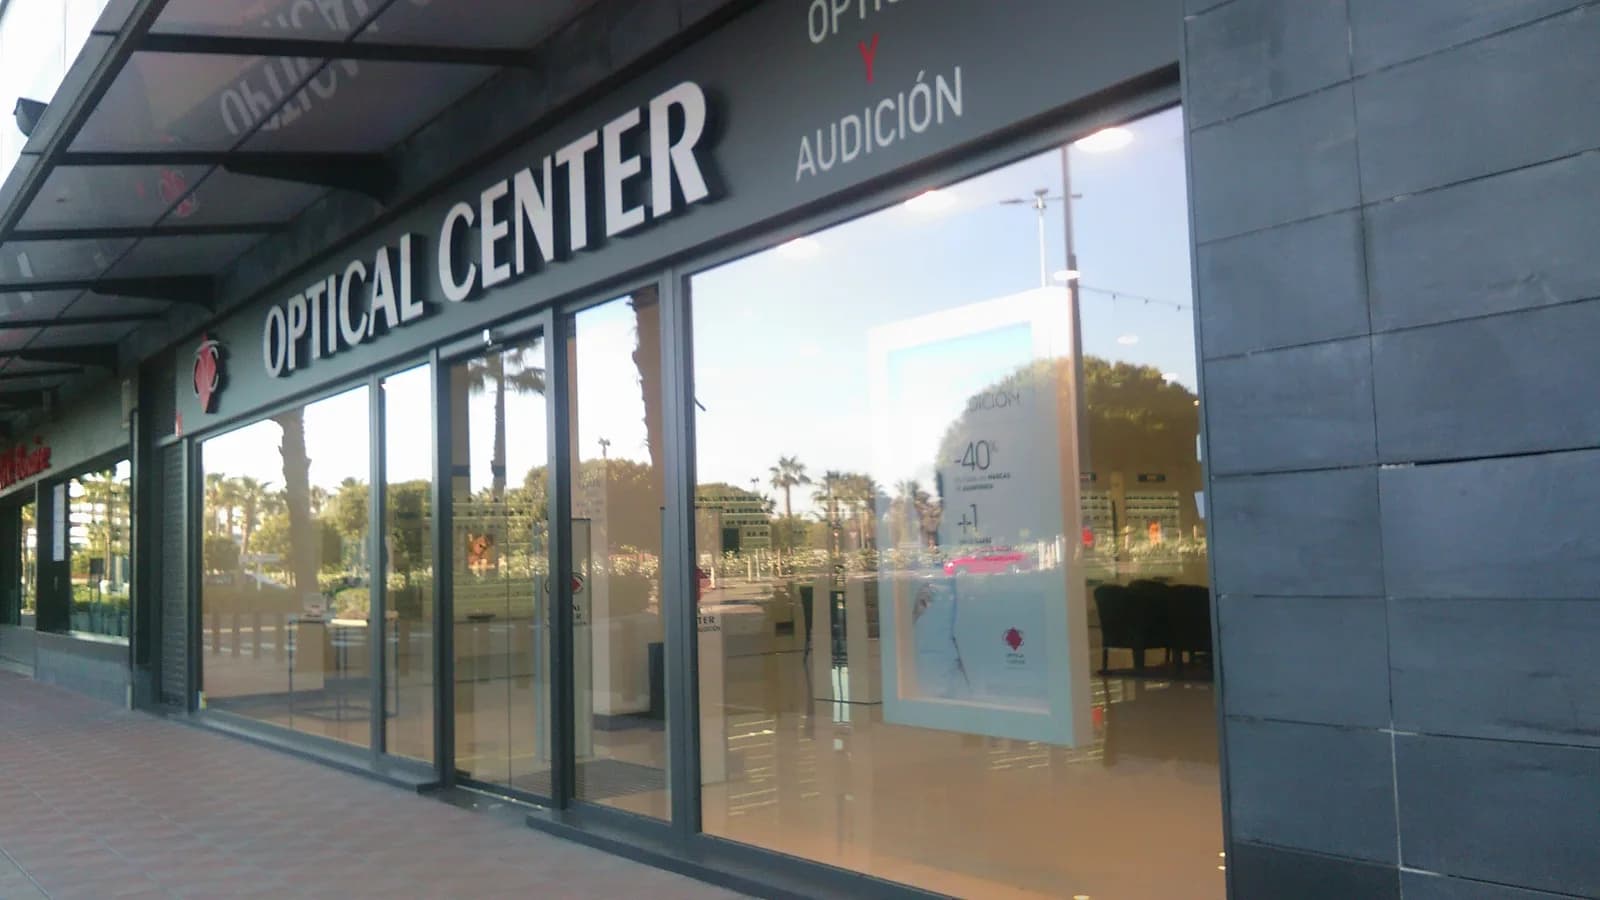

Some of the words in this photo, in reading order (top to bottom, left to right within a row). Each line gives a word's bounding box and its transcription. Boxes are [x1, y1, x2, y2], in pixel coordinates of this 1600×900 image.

[857, 33, 879, 85] Y
[796, 66, 962, 182] AUDICIÓN
[263, 232, 424, 377] OPTICAL
[438, 81, 708, 301] CENTER
